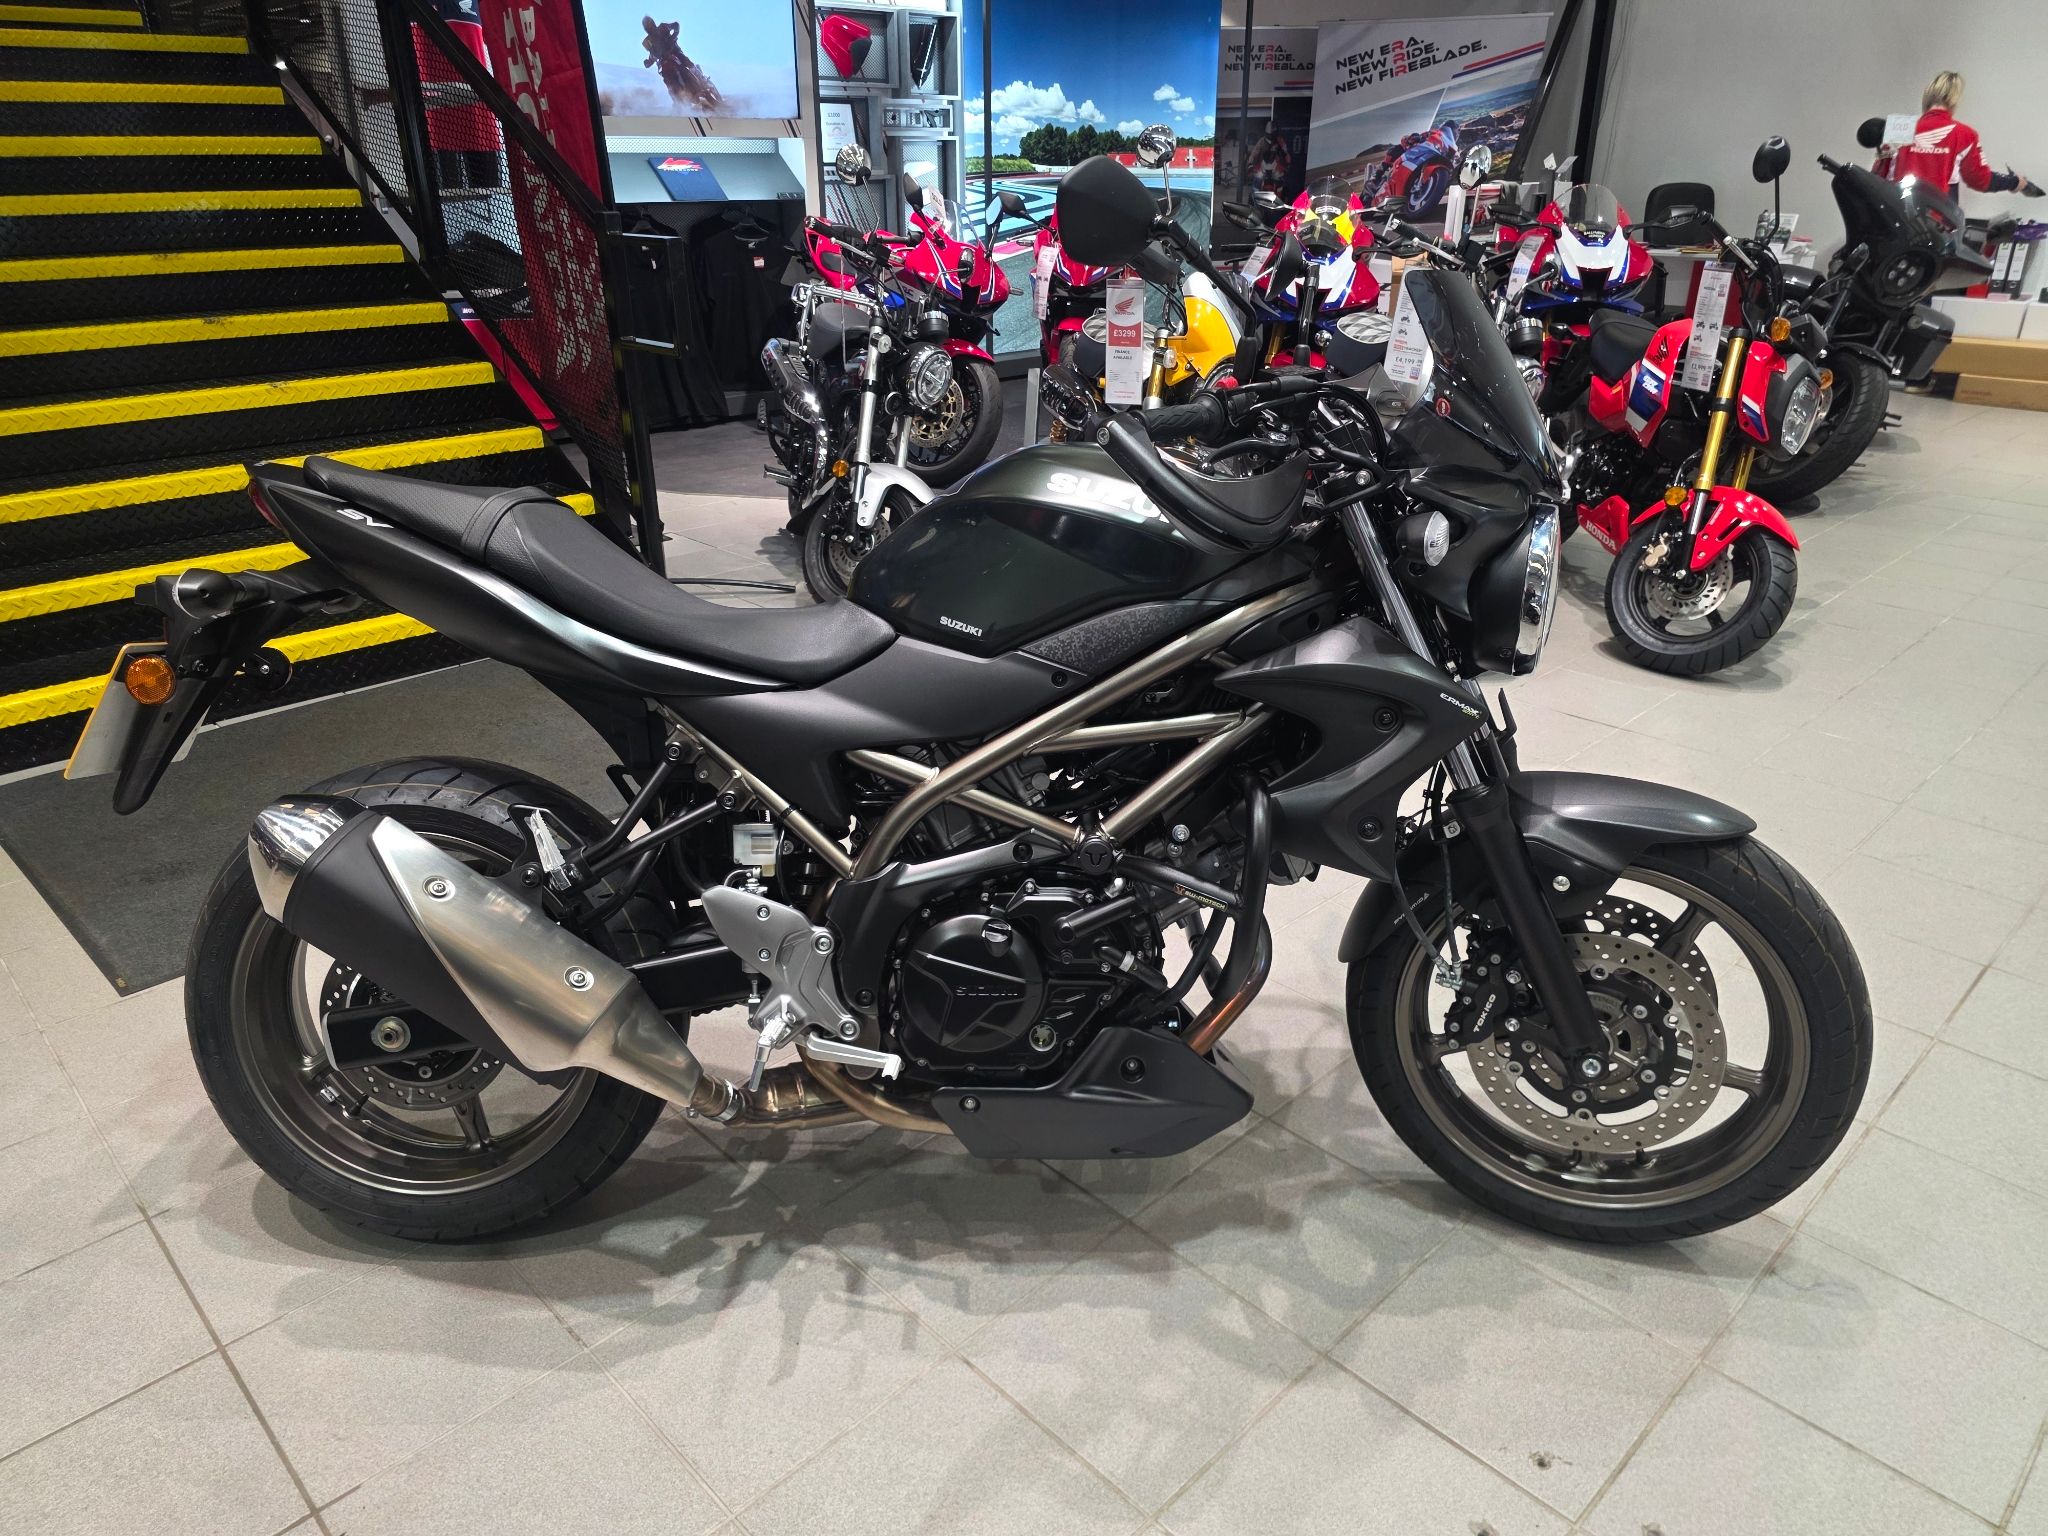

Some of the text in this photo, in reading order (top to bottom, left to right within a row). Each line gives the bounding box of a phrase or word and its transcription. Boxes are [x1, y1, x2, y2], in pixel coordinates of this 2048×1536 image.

[1235, 54, 1296, 62] NW RIDE.
[1258, 45, 1287, 53] ERA.
[1336, 36, 1424, 70] NEW ERA.
[1348, 42, 1439, 78] NEW RIDE.
[1254, 63, 1314, 71] FIREBLAD
[1335, 40, 1487, 95] NEW FIREBLADE.
[1910, 146, 1950, 154] HONDA
[519, 6, 592, 373] BALLMENA
[1113, 329, 1136, 338] £3299
[1046, 472, 1170, 524] SUZU
[336, 508, 395, 529] SV
[1585, 519, 1617, 552] HONDA
[939, 615, 983, 637] SUZUKI
[1439, 692, 1479, 714] ERMAX
[1472, 993, 1497, 1033] TOKICO
